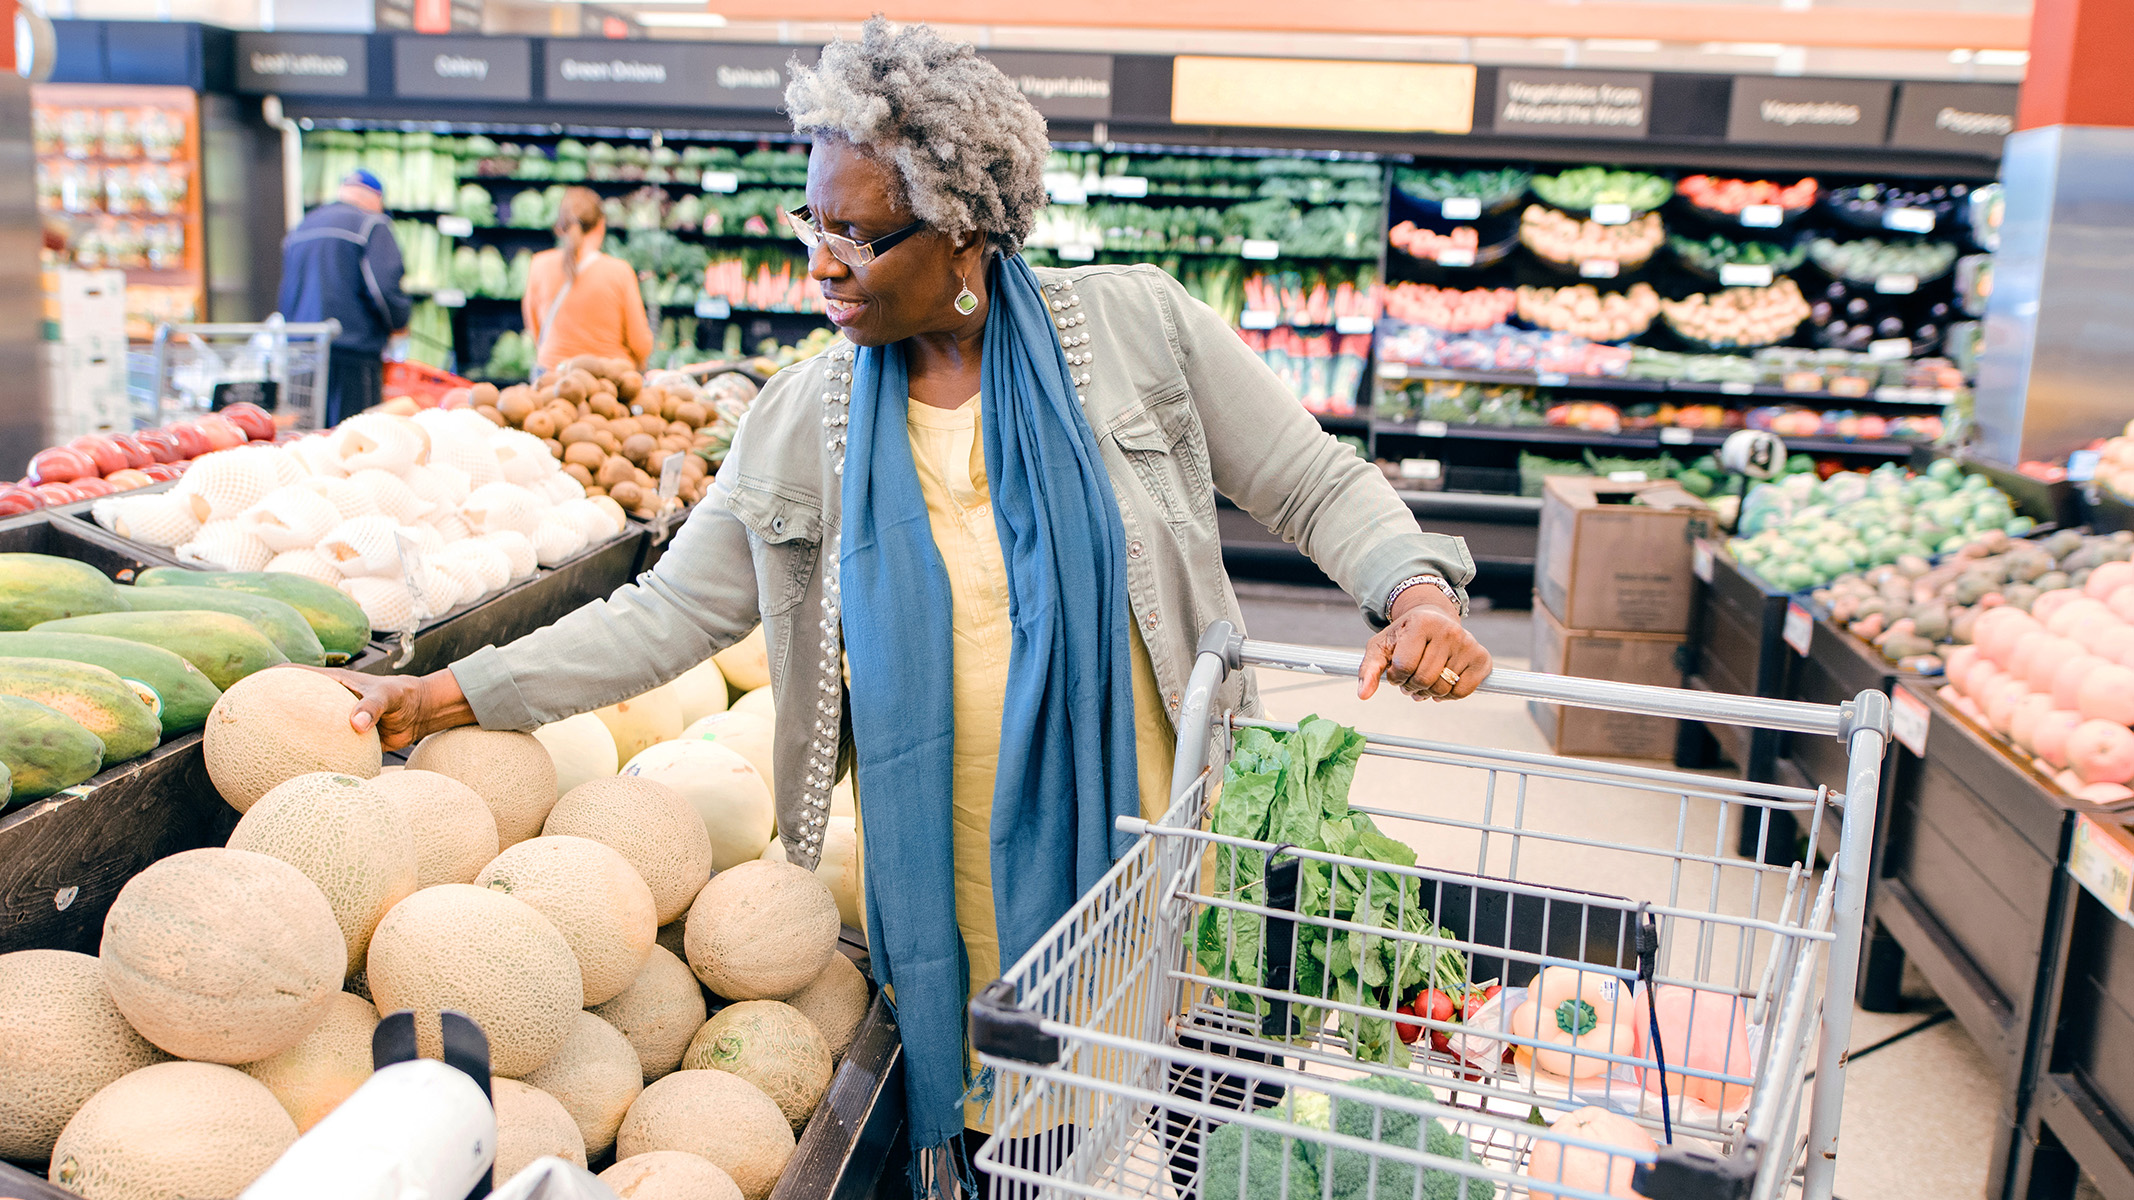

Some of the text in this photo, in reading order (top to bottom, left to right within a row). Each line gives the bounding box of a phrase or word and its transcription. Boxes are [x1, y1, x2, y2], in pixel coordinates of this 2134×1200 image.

[288, 53, 348, 76] Lettuce
[434, 54, 488, 81] Celery
[561, 59, 667, 83] Green Onions
[716, 65, 781, 90] Spinach
[1020, 75, 1110, 99] Vegetables
[1508, 81, 1599, 106] Vegetables
[1503, 102, 1644, 127] Around the World
[1760, 100, 1861, 126] Vegetables
